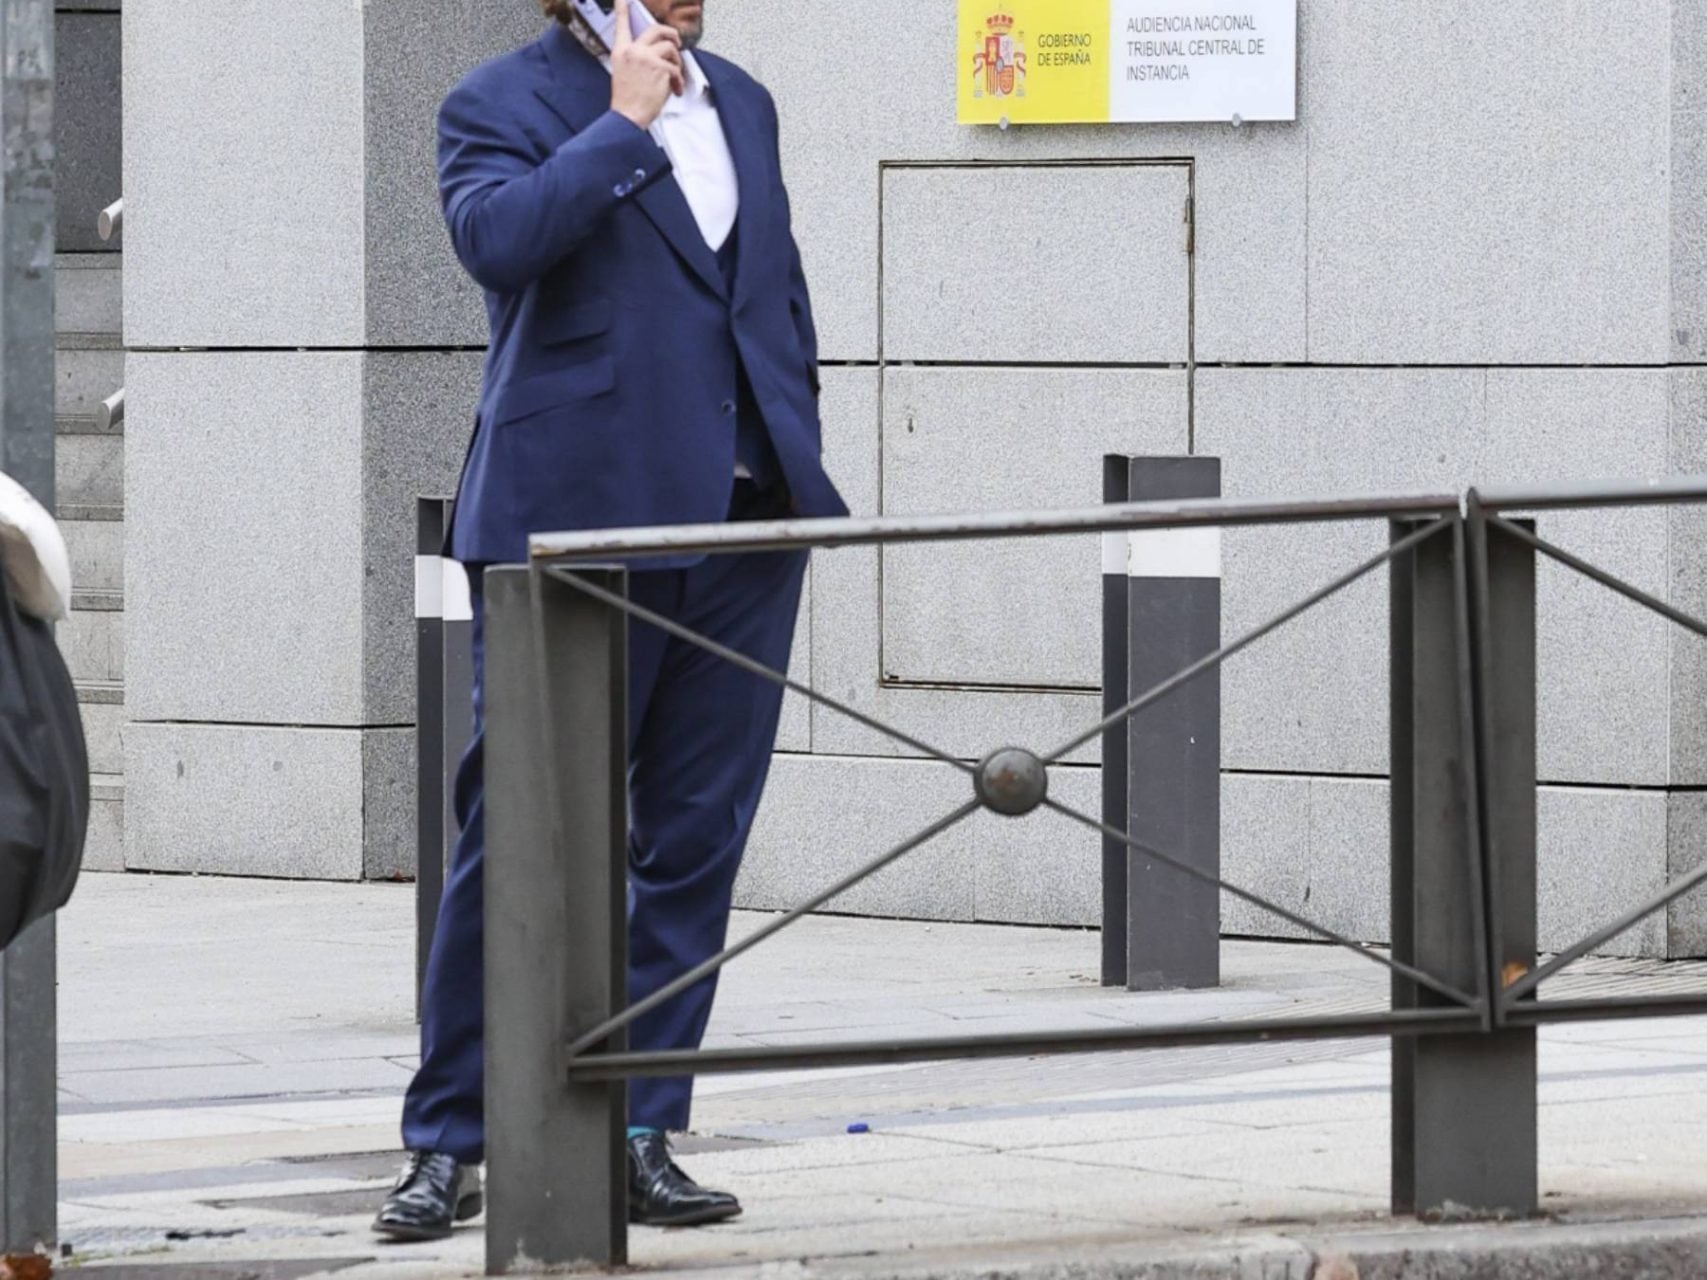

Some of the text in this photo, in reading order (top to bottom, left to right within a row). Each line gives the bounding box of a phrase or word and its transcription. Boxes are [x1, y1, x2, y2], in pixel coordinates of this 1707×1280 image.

[1127, 15, 1256, 33] AUDIENCIA NACIONAL
[1038, 33, 1092, 48] GOBIERNO
[1127, 38, 1265, 57] TRIBUNAL CENTRAL DE
[1038, 48, 1091, 66] DE ESPAÑA
[1126, 64, 1190, 81] INSTANCIA
